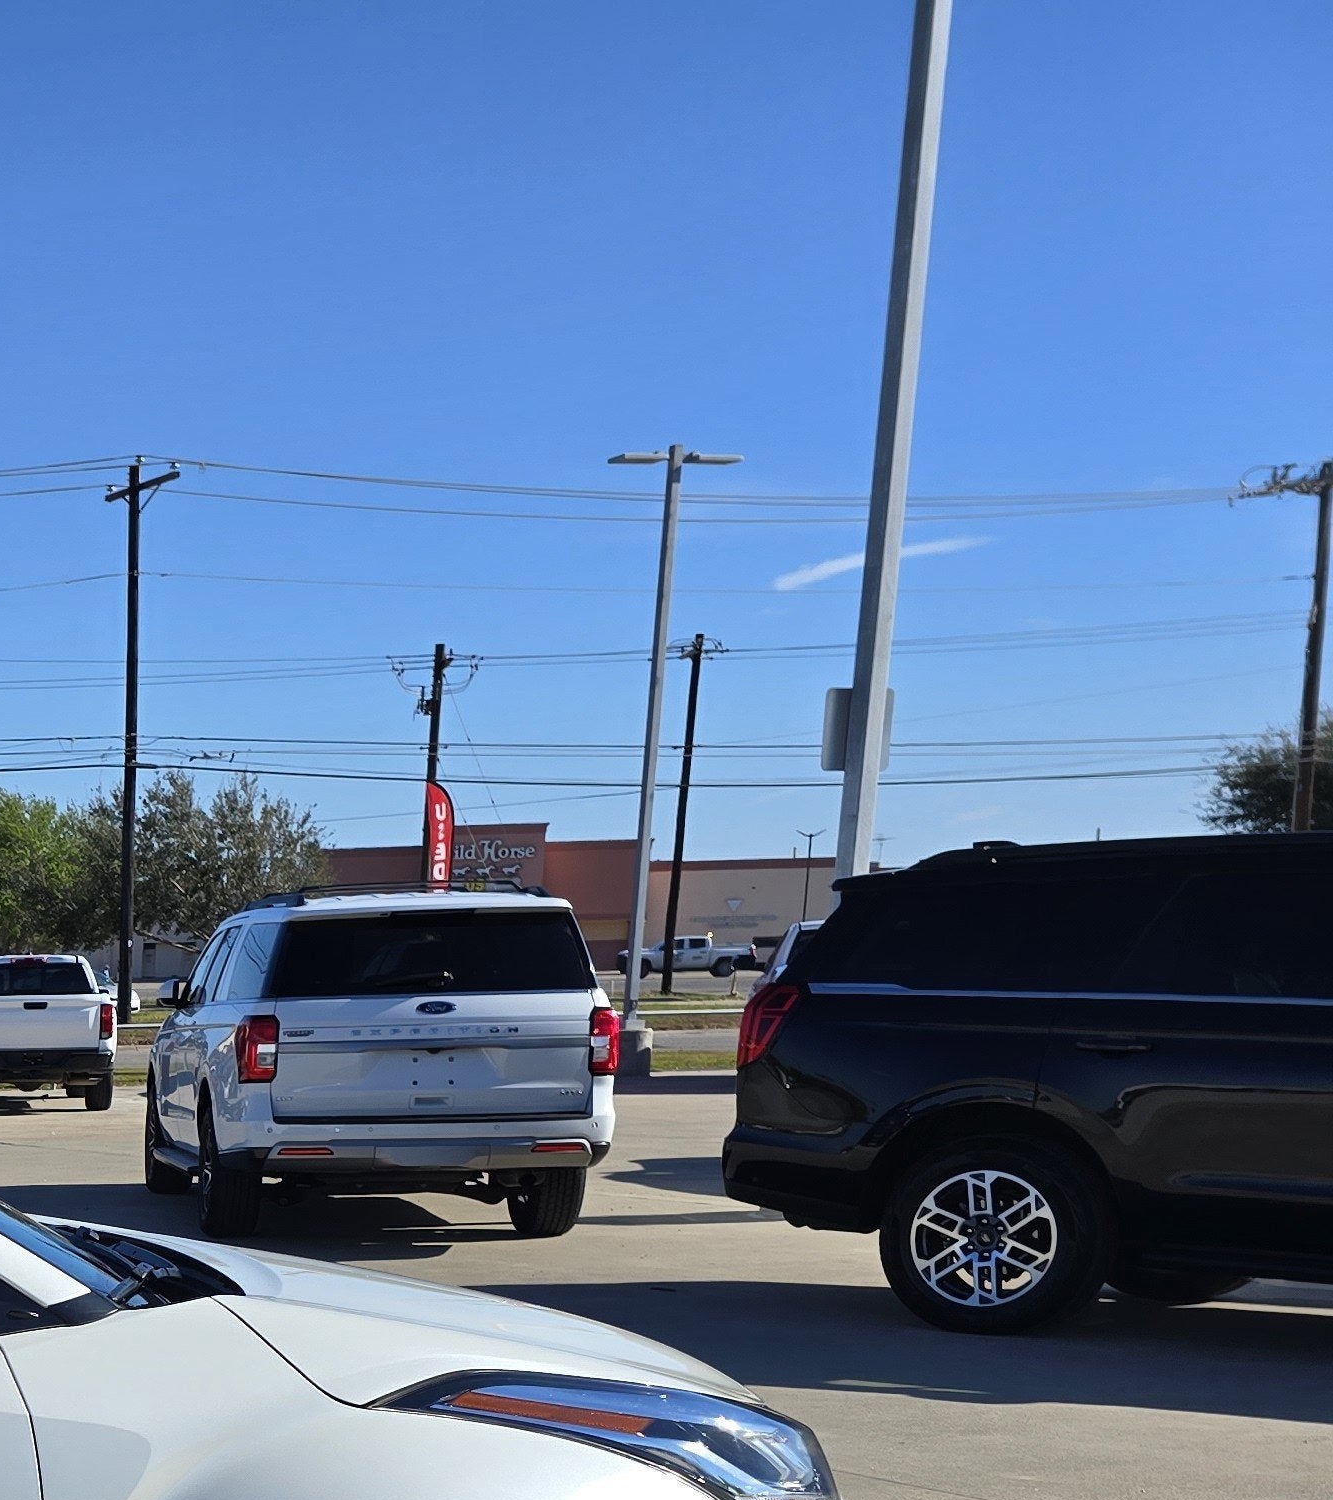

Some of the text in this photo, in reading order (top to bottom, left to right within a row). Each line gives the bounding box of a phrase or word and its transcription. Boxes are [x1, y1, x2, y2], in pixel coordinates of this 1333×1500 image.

[454, 840, 536, 862] ild Horse
[351, 1025, 519, 1037] EXPEDITION
